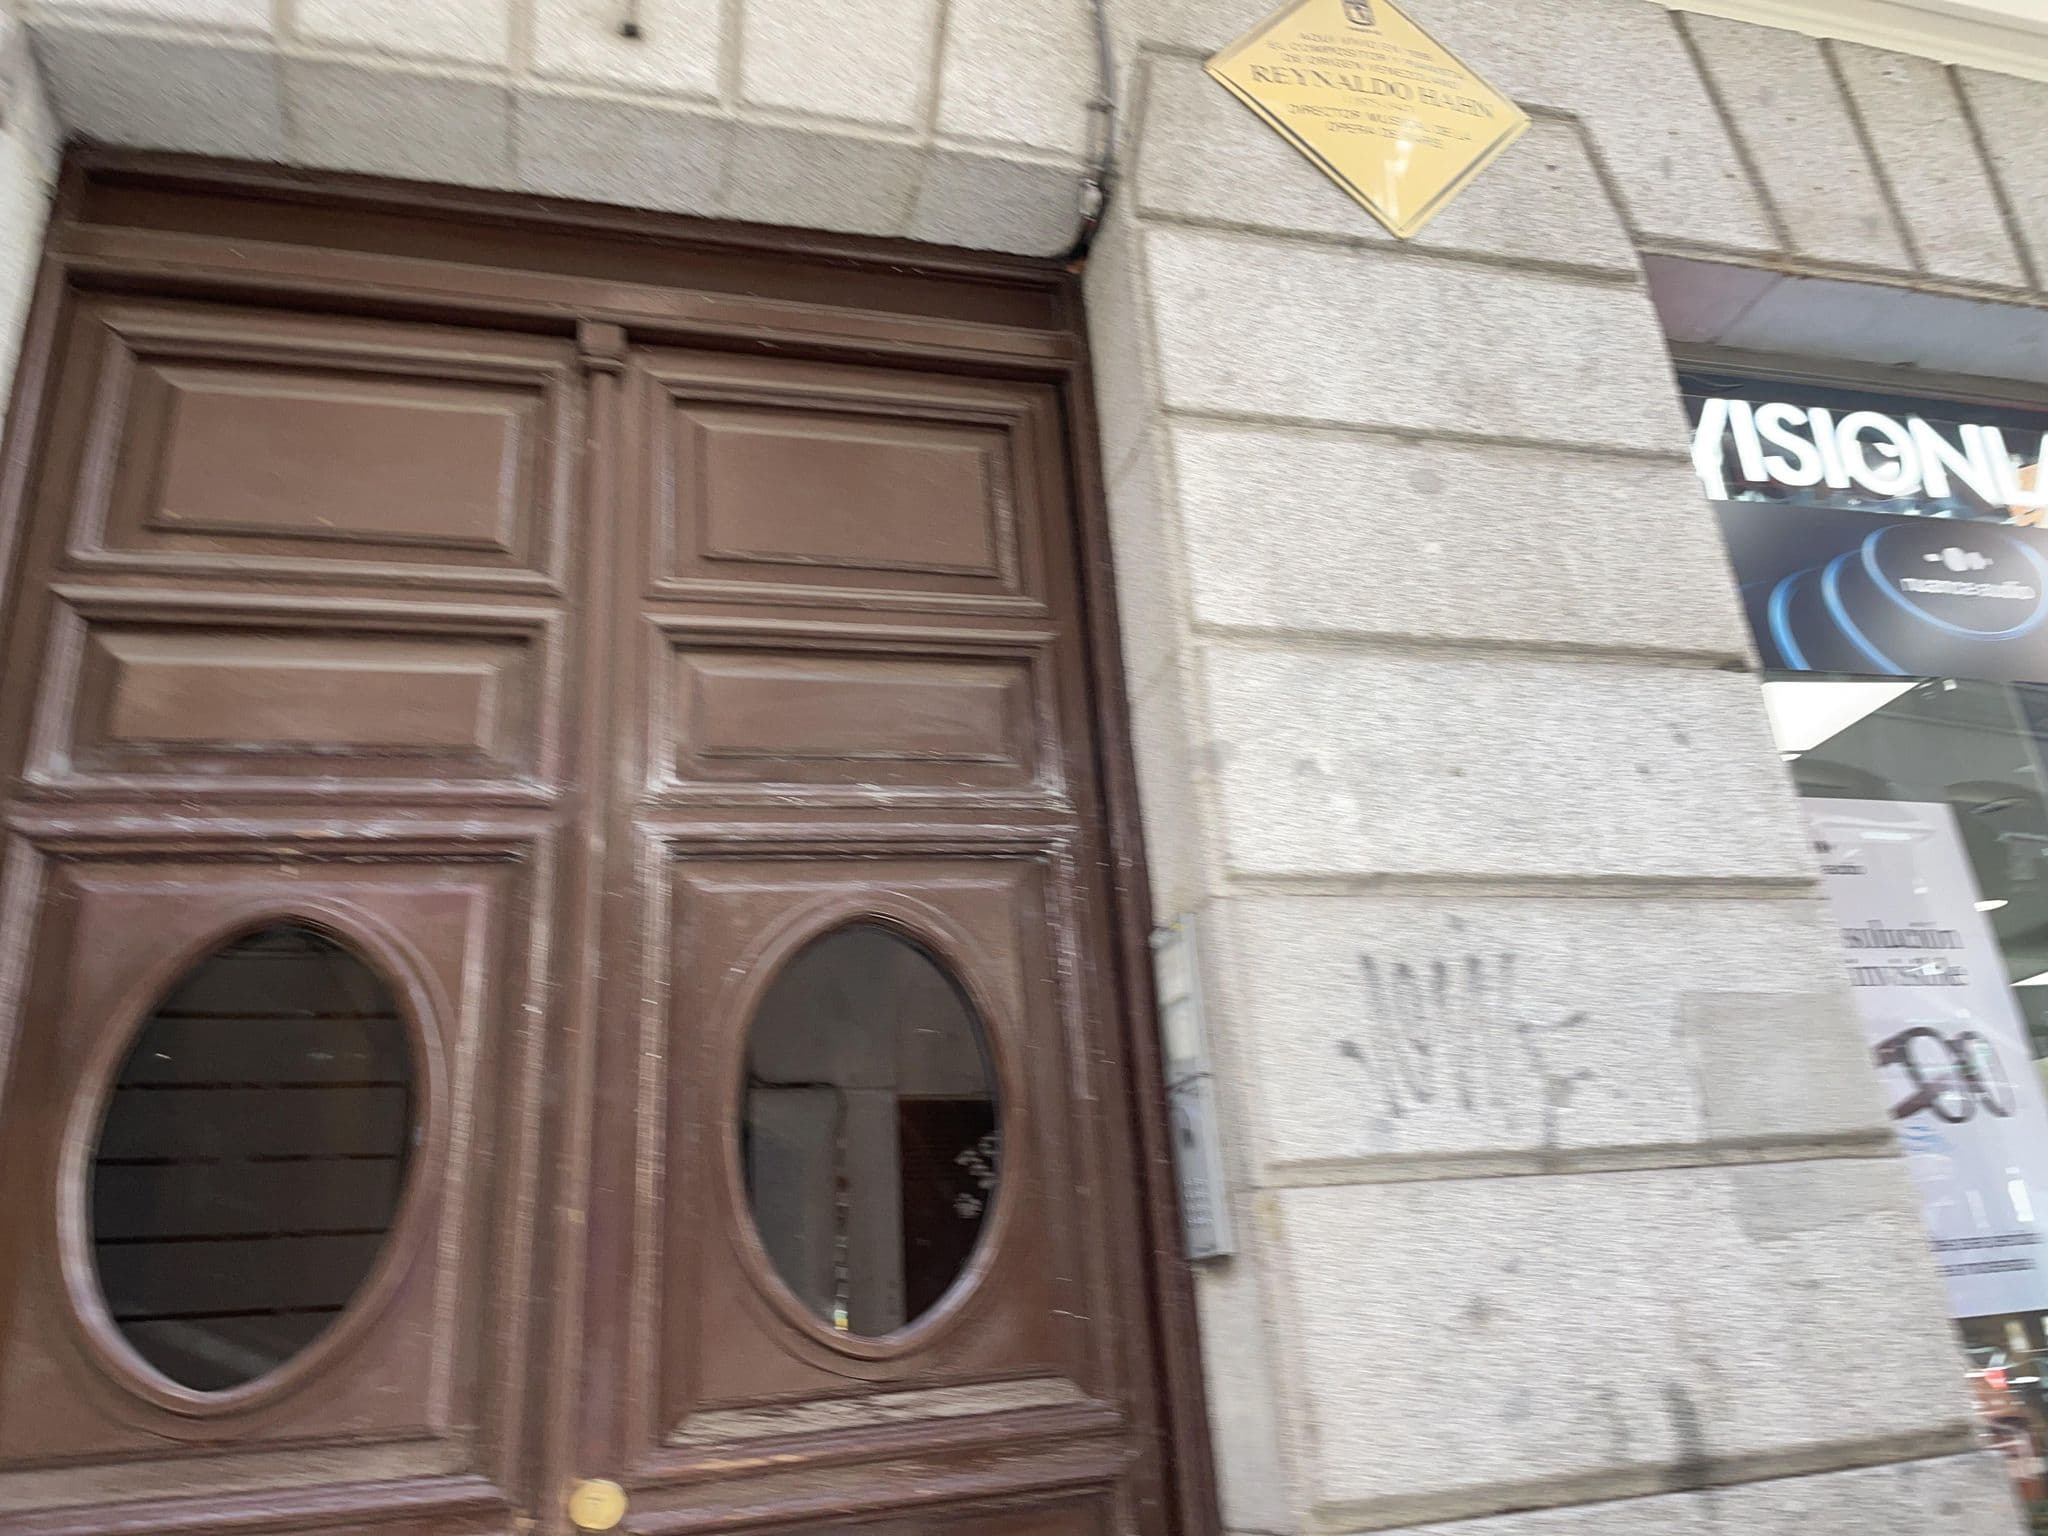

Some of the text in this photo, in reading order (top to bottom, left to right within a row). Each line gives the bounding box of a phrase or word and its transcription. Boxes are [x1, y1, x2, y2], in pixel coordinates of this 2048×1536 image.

[1249, 64, 1413, 100] REYNALDO
[1417, 86, 1494, 118] HAHN
[1690, 398, 2048, 507] VISIONL
